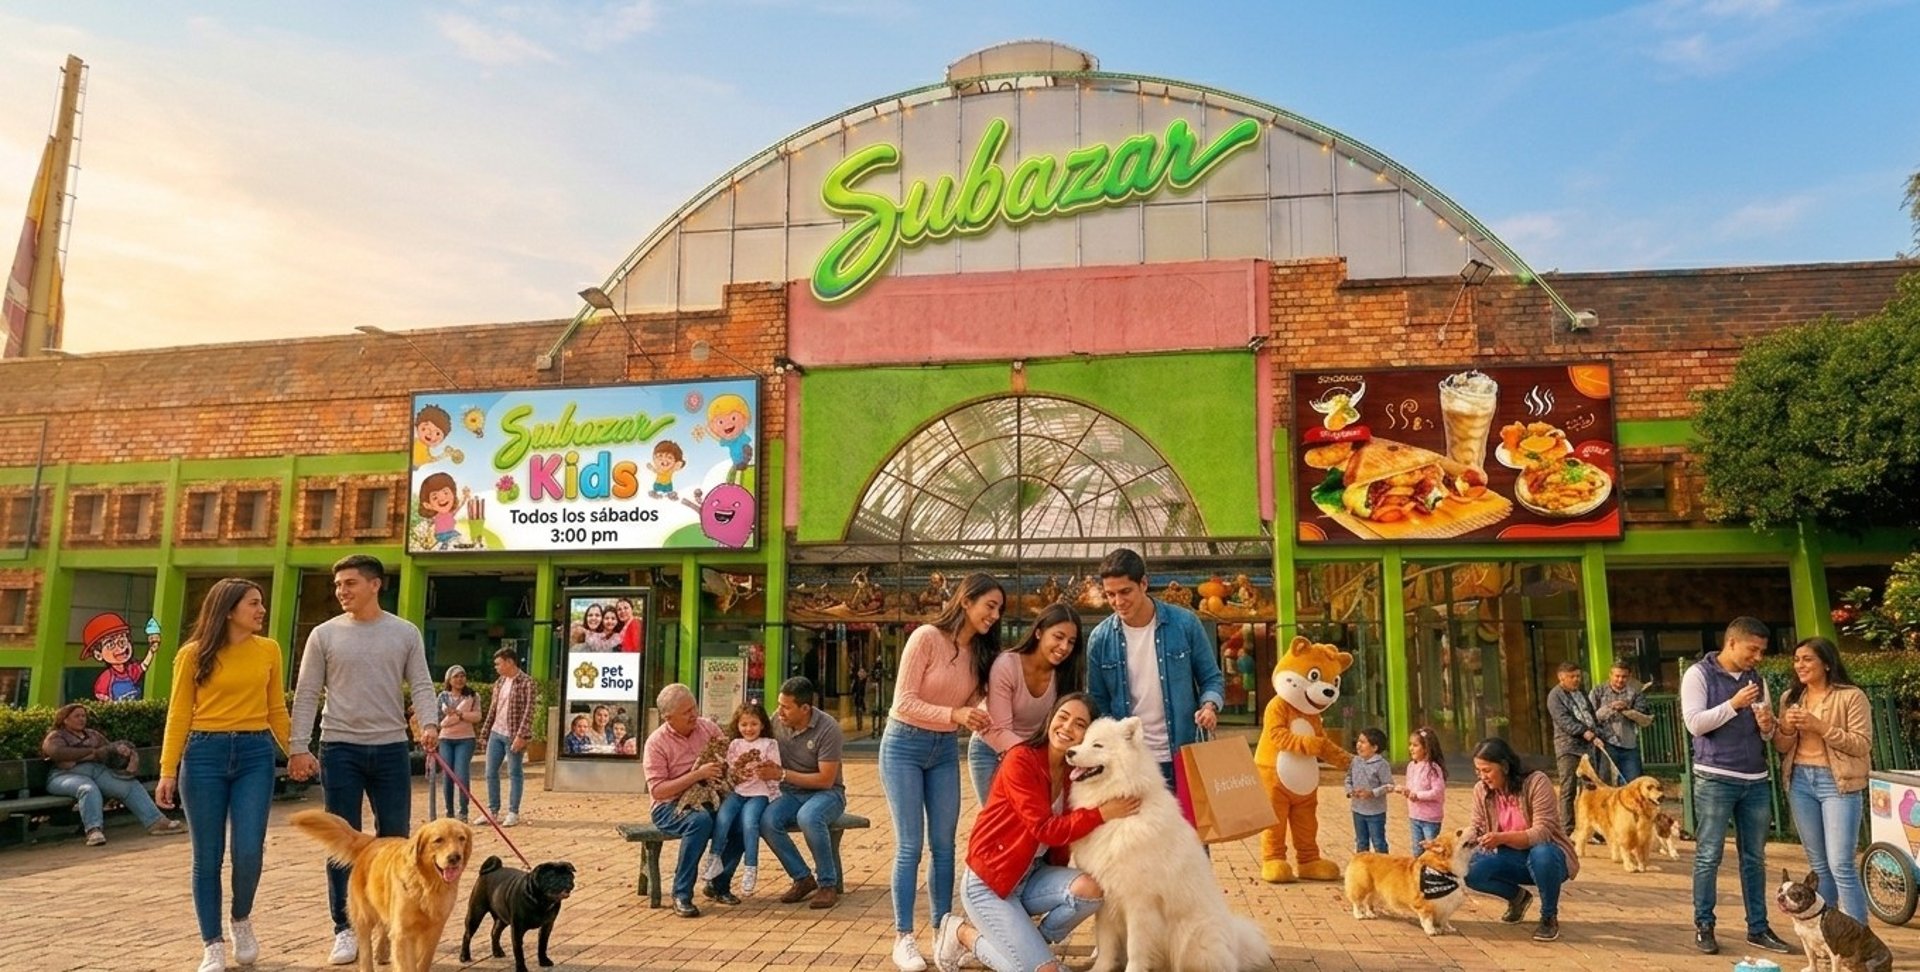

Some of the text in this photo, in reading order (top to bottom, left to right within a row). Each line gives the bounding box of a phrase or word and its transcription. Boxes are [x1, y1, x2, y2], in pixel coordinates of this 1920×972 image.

[811, 118, 1260, 300] Subazar
[494, 403, 675, 470] Subazar
[529, 451, 639, 500] Kids
[510, 507, 659, 524] Todos los sábados
[550, 528, 618, 545] 3:00 pm
[601, 677, 633, 691] Shop
